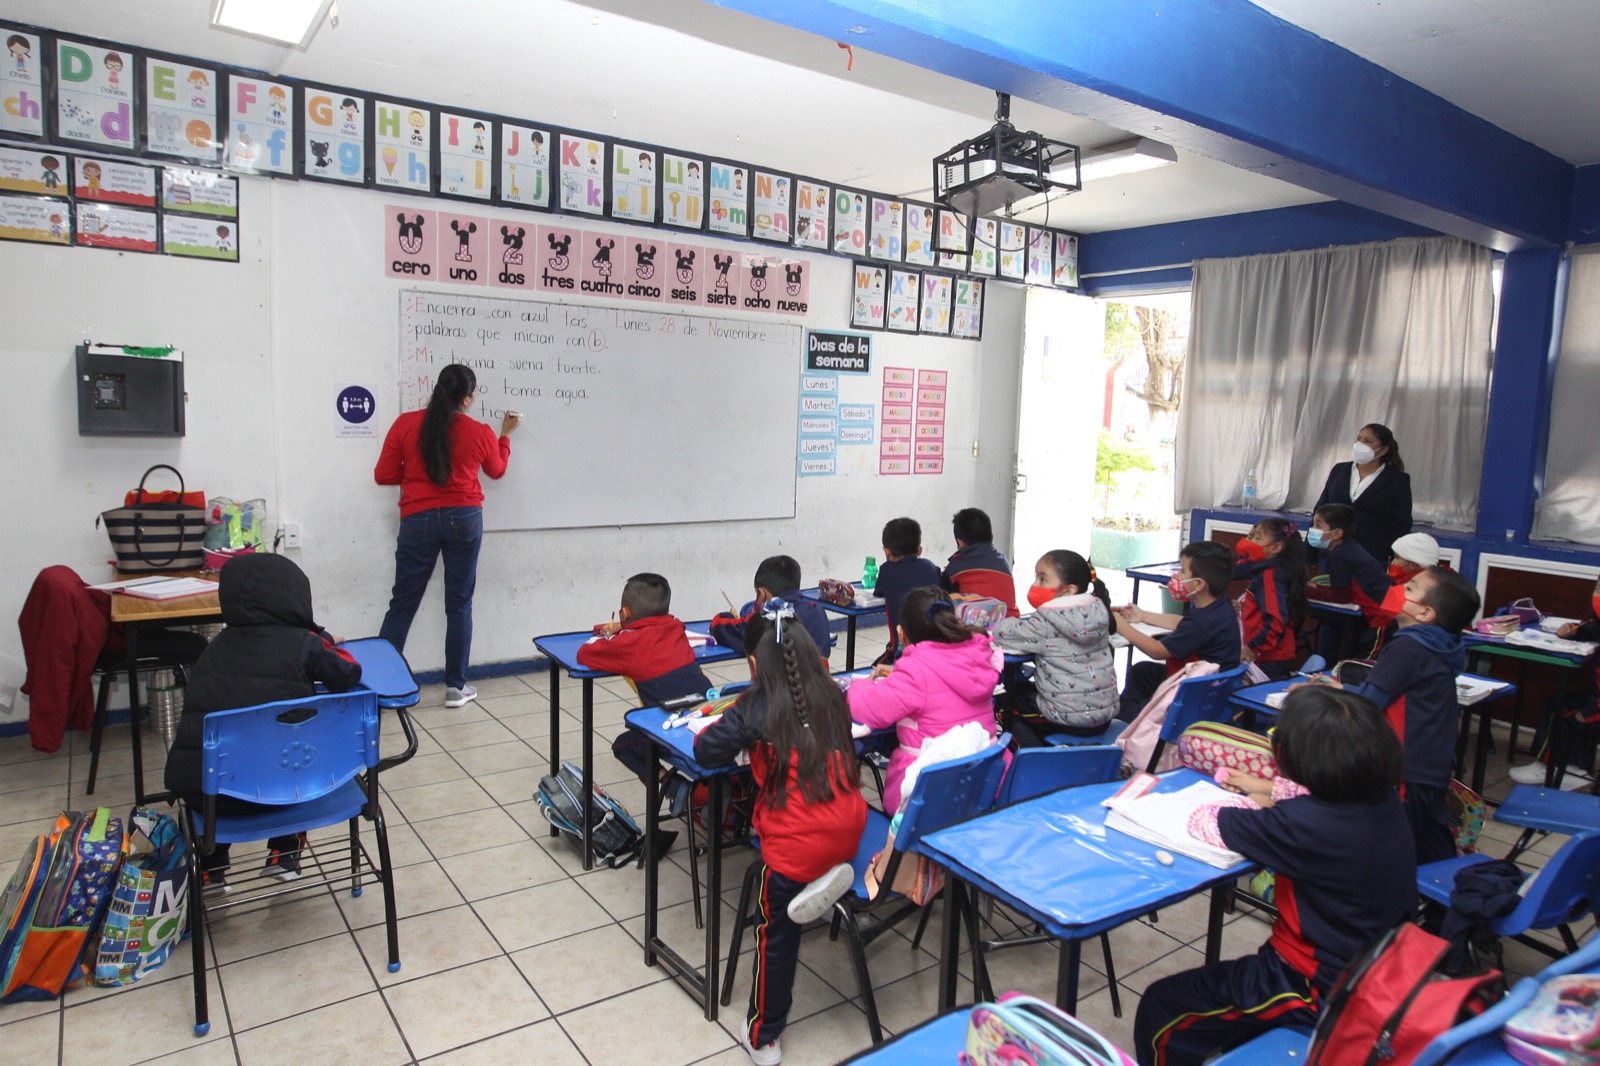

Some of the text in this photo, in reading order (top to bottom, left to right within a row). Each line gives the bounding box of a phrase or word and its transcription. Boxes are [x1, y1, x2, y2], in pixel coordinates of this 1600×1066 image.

[61, 45, 93, 82] D
[153, 66, 176, 101] E
[4, 91, 40, 120] ch
[237, 81, 257, 114] F
[100, 102, 130, 141] d
[308, 95, 333, 127] G
[378, 106, 400, 139] H
[185, 119, 212, 148] e
[448, 117, 459, 147] I
[507, 130, 520, 156] J
[266, 129, 286, 166] f
[338, 141, 361, 176] g
[562, 139, 581, 167] K
[408, 151, 427, 185] h
[616, 148, 630, 175] L
[533, 169, 543, 200] j
[711, 166, 730, 190] M
[756, 175, 772, 199] N
[587, 179, 602, 208] k
[798, 184, 812, 210] Ñ
[836, 192, 851, 215] O
[729, 207, 746, 225] m
[773, 212, 788, 233] n
[874, 201, 886, 222] P
[908, 208, 920, 231] Q
[398, 222, 423, 254] 0
[941, 215, 953, 236] R
[1002, 224, 1012, 244] T
[455, 230, 473, 262] 1
[502, 234, 524, 265] 2
[888, 235, 900, 259] p
[1030, 230, 1041, 249] U
[1056, 237, 1067, 256] V
[392, 260, 431, 276] cero
[548, 241, 570, 271] 3
[592, 246, 612, 276] 4
[635, 252, 655, 280] 5
[449, 267, 478, 281] uno
[498, 263, 525, 285] dos
[542, 267, 575, 289] tres
[676, 256, 694, 284] 6
[715, 262, 731, 288] 7
[750, 265, 767, 292] 8
[856, 271, 871, 290] W
[580, 276, 624, 295] cuatro
[627, 280, 661, 298] cinco
[671, 286, 697, 301] seis
[707, 286, 737, 305] siete
[786, 271, 801, 296] 9
[891, 275, 904, 296] X
[925, 278, 938, 299] Y
[957, 283, 969, 305] Z
[415, 297, 588, 328] Encierra con azul las
[744, 291, 771, 309] ocho
[777, 299, 808, 313] nueve
[415, 320, 467, 341] palabras
[477, 328, 501, 346] que
[514, 331, 555, 344] inician
[566, 336, 586, 348] con
[615, 311, 766, 342] Lunes 28 de Noviembre
[838, 336, 855, 353] de
[857, 337, 869, 354] la
[415, 346, 433, 364] Mi
[509, 359, 544, 371] suena
[815, 355, 864, 369] semana
[418, 376, 435, 393] Mi
[502, 378, 541, 397] toma
